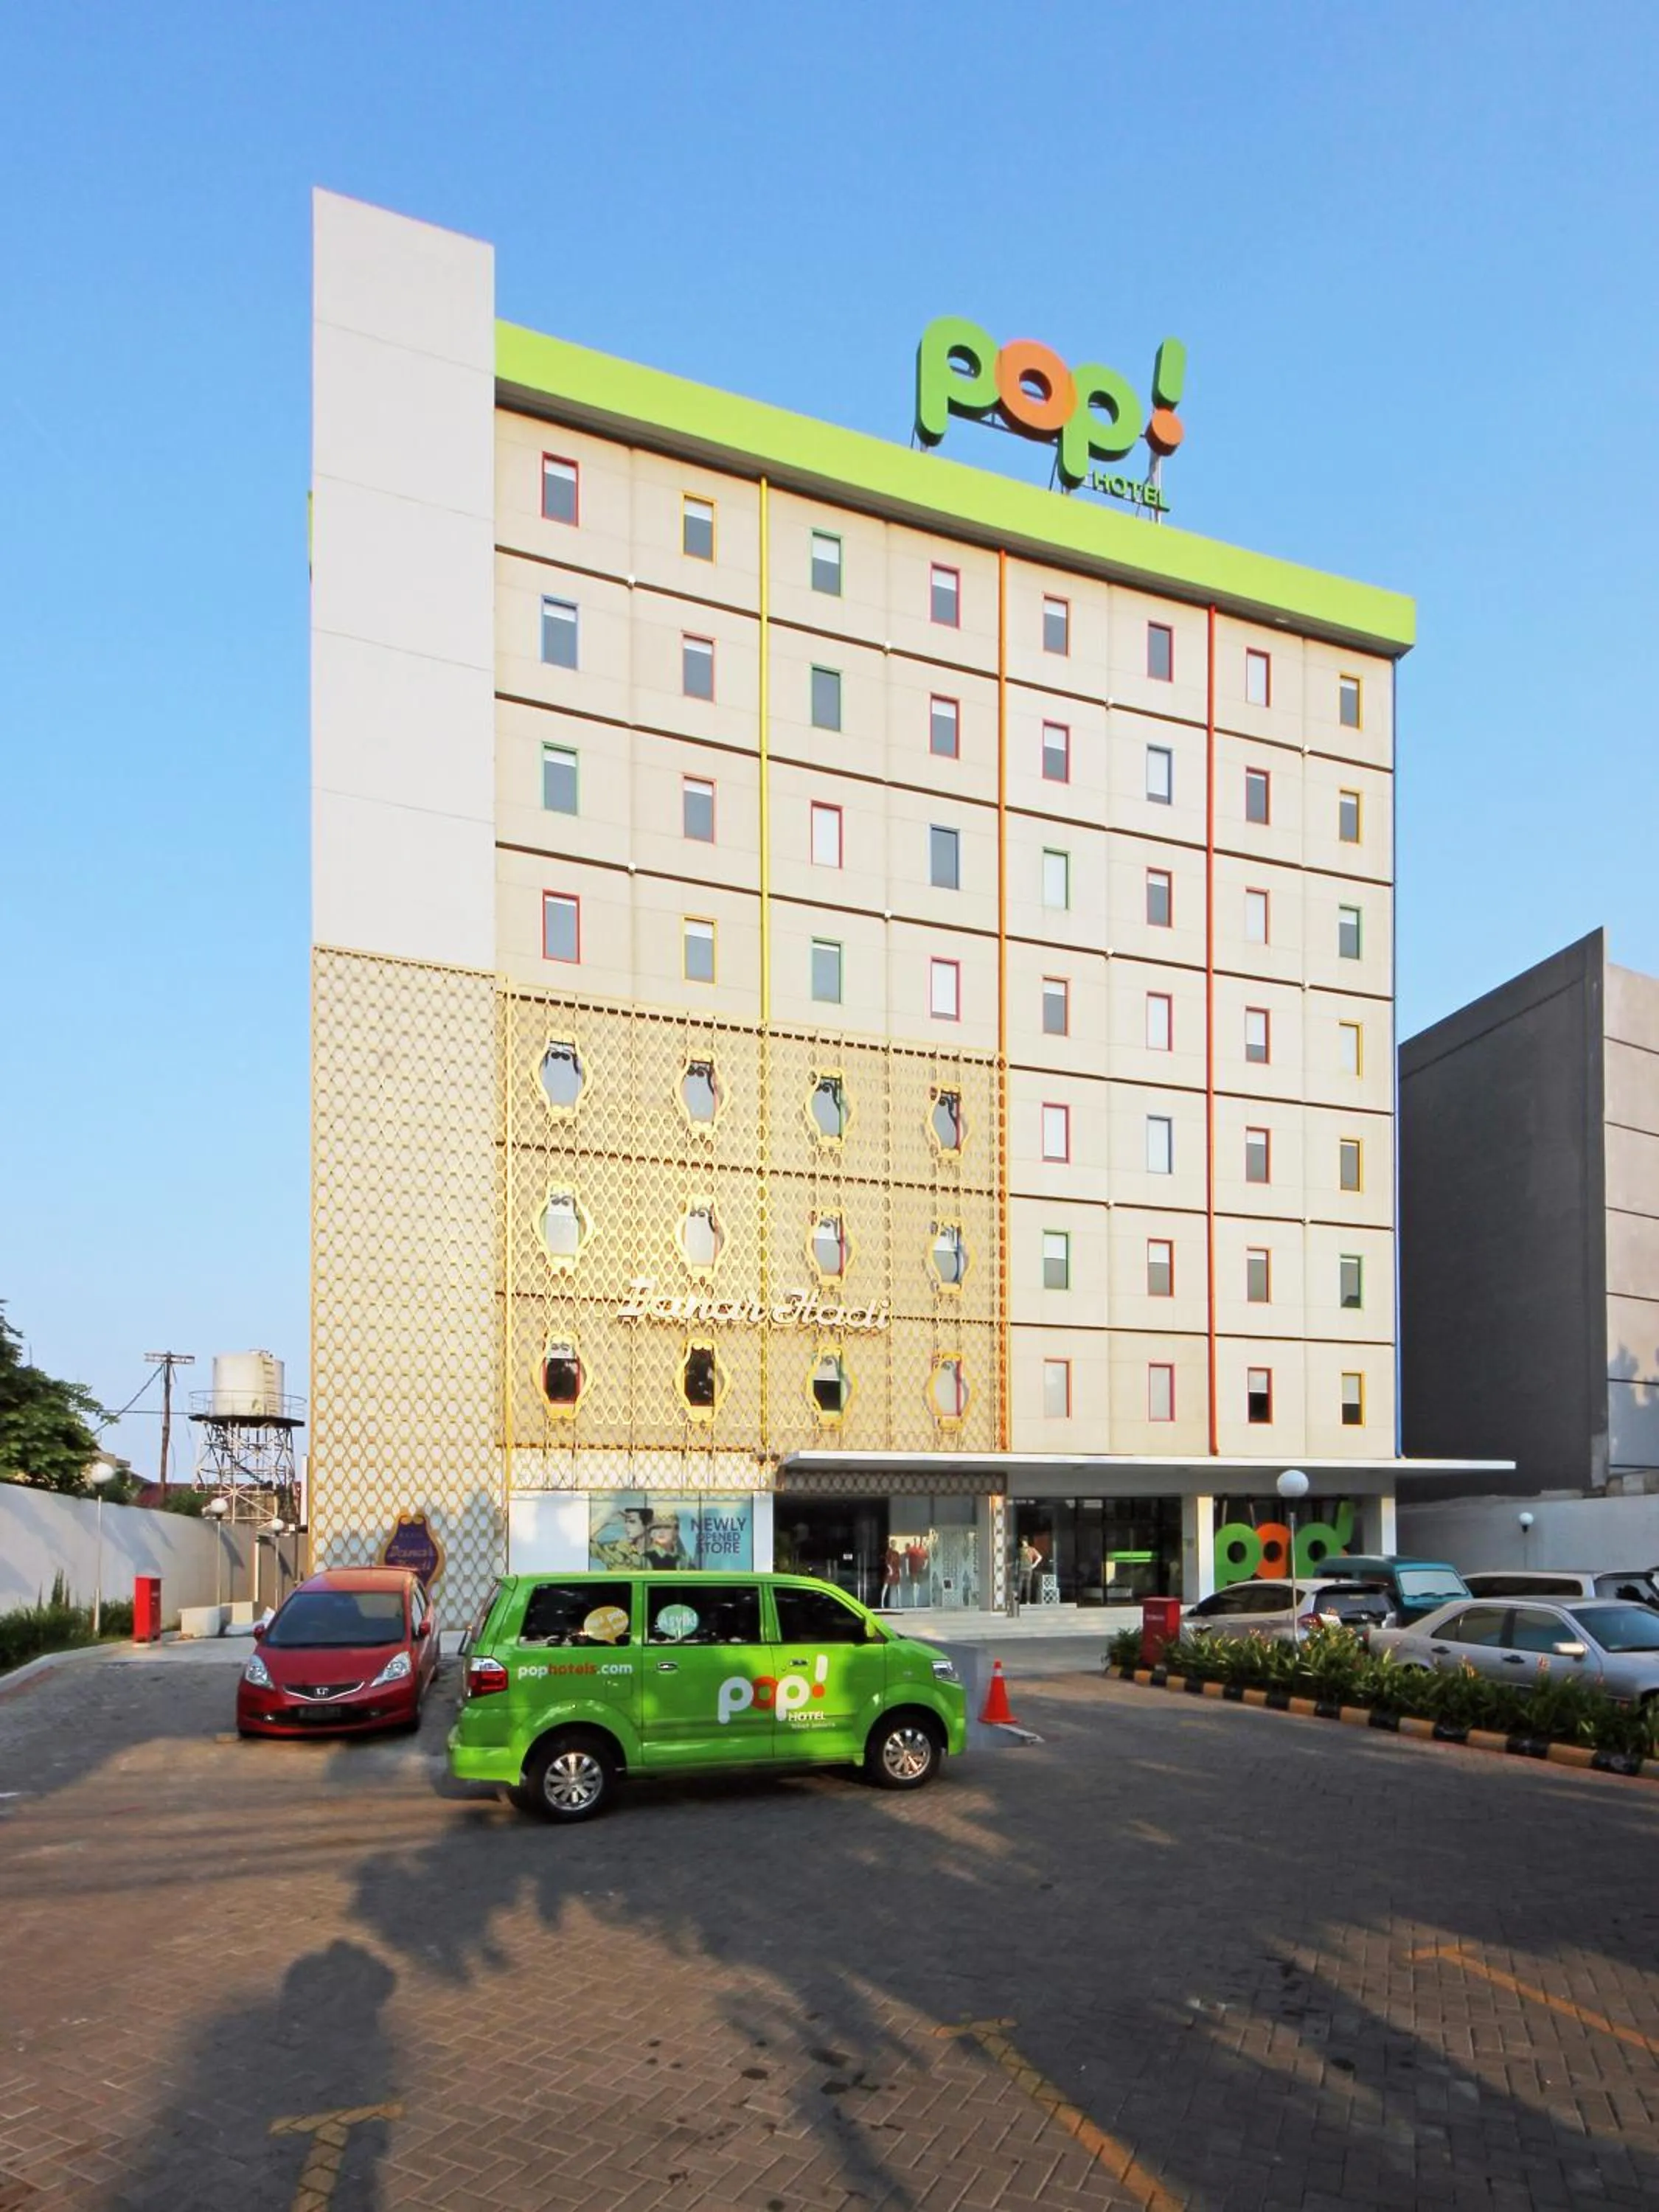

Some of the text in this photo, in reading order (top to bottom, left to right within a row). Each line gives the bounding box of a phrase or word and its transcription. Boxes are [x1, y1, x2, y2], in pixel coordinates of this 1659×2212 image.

[917, 315, 1187, 488] pop!
[1093, 470, 1170, 512] HOTEL
[691, 1517, 746, 1531] NEWLY
[518, 1663, 633, 1680] pophotels.com
[717, 1654, 829, 1724] pop!
[788, 1711, 826, 1722] HOTEL
